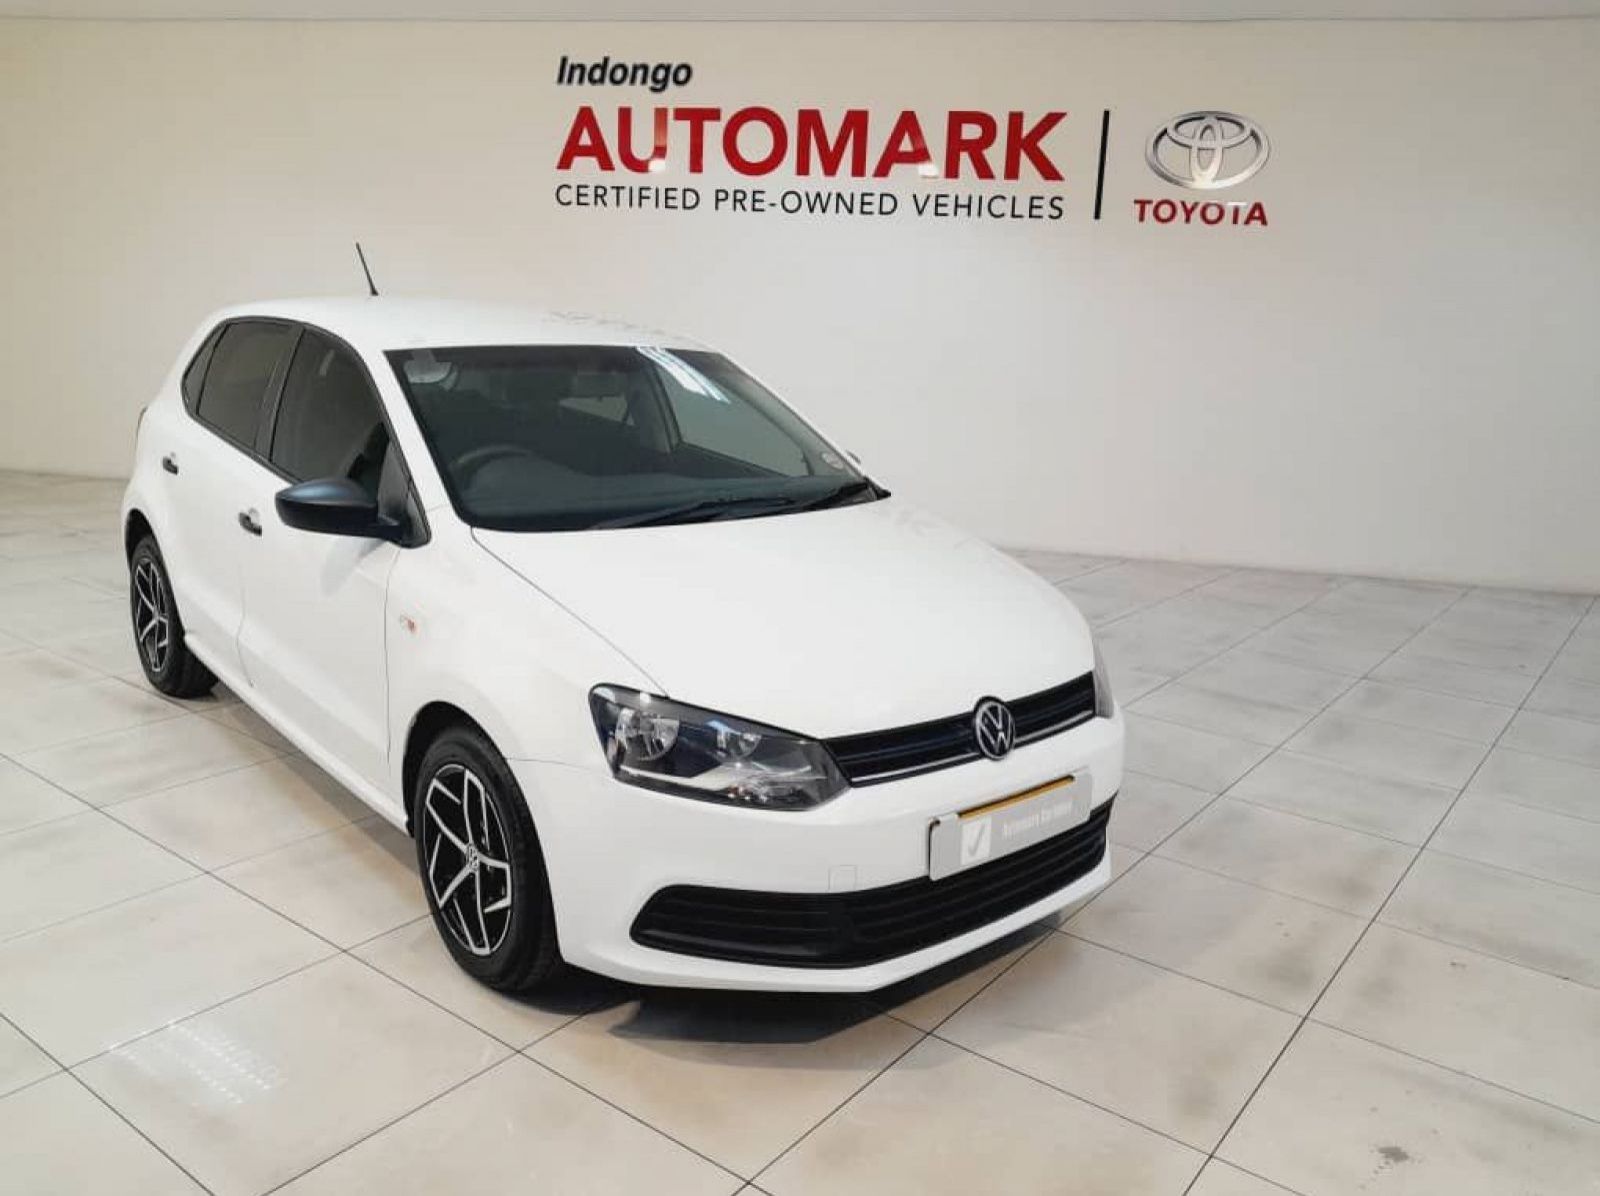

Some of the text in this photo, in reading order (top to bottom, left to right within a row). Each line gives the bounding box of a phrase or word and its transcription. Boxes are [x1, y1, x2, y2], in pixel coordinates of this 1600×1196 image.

[556, 56, 693, 92] Indongo
[556, 107, 1067, 181] AUTOMARK
[555, 184, 1064, 220] CERTIFIED PRE-OWNED VEHICLES
[1134, 199, 1268, 226] TOYOTA
